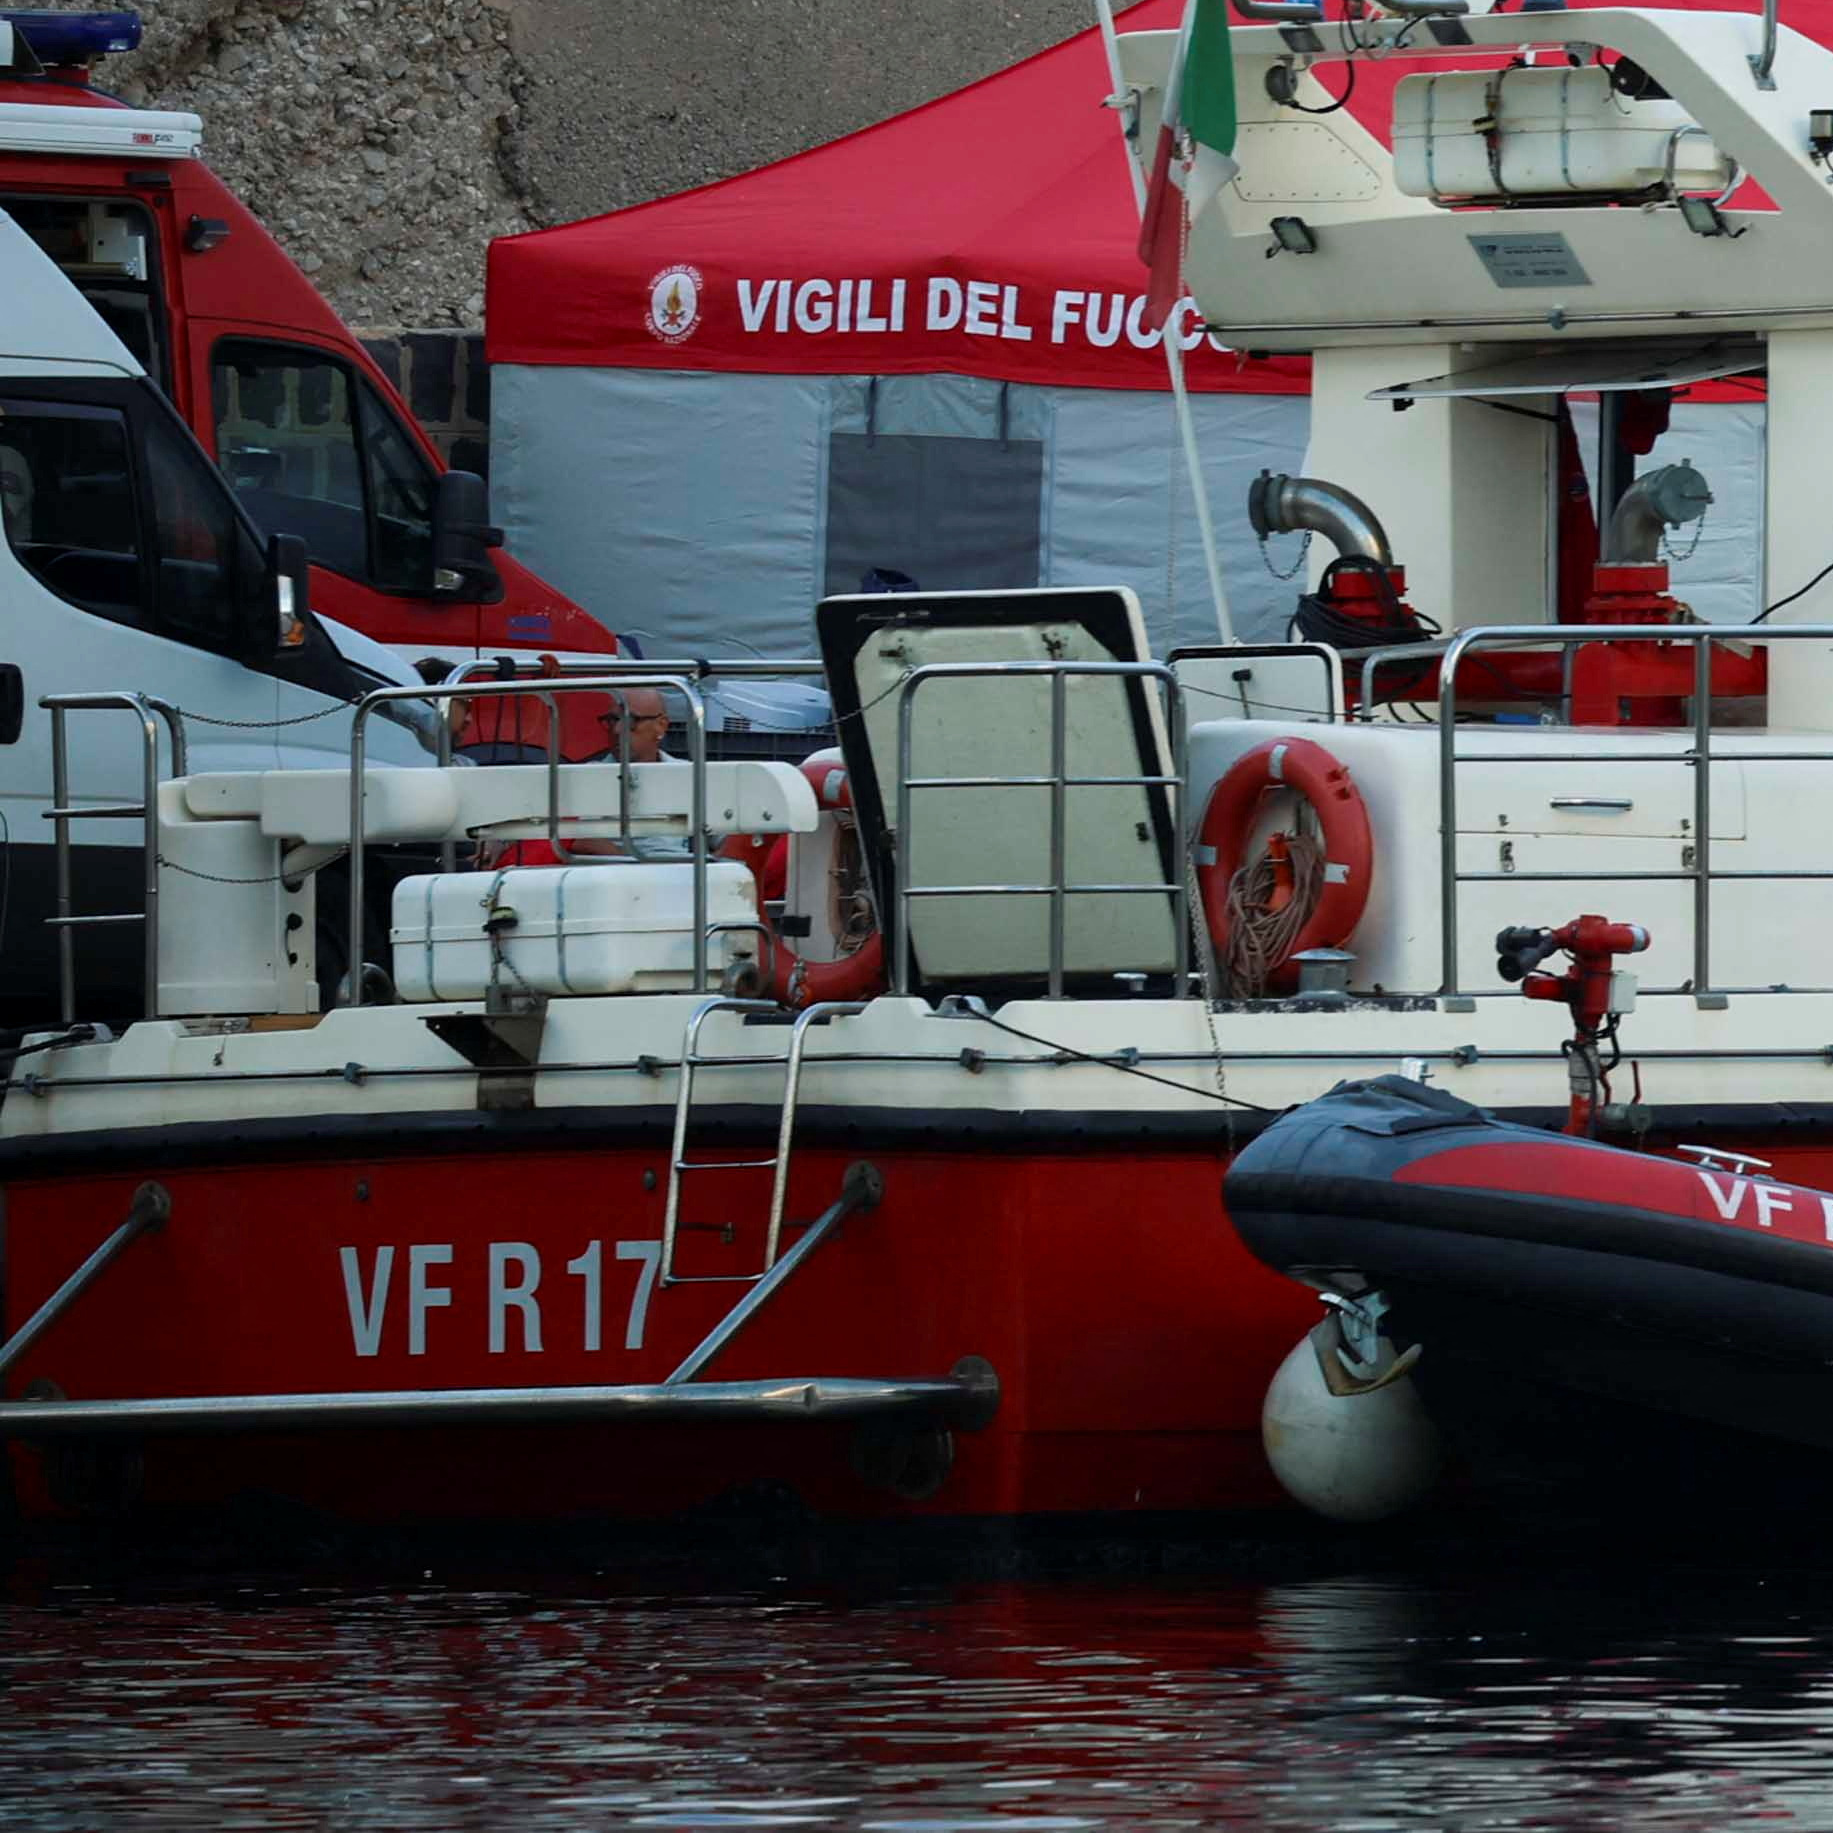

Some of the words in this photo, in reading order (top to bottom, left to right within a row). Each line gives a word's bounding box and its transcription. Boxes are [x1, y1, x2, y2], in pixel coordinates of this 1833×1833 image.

[737, 278, 906, 333] VIGILI
[927, 277, 1033, 342] DEL
[1698, 1171, 1793, 1227] VF
[339, 1244, 454, 1357] VF
[488, 1239, 662, 1354] R17
